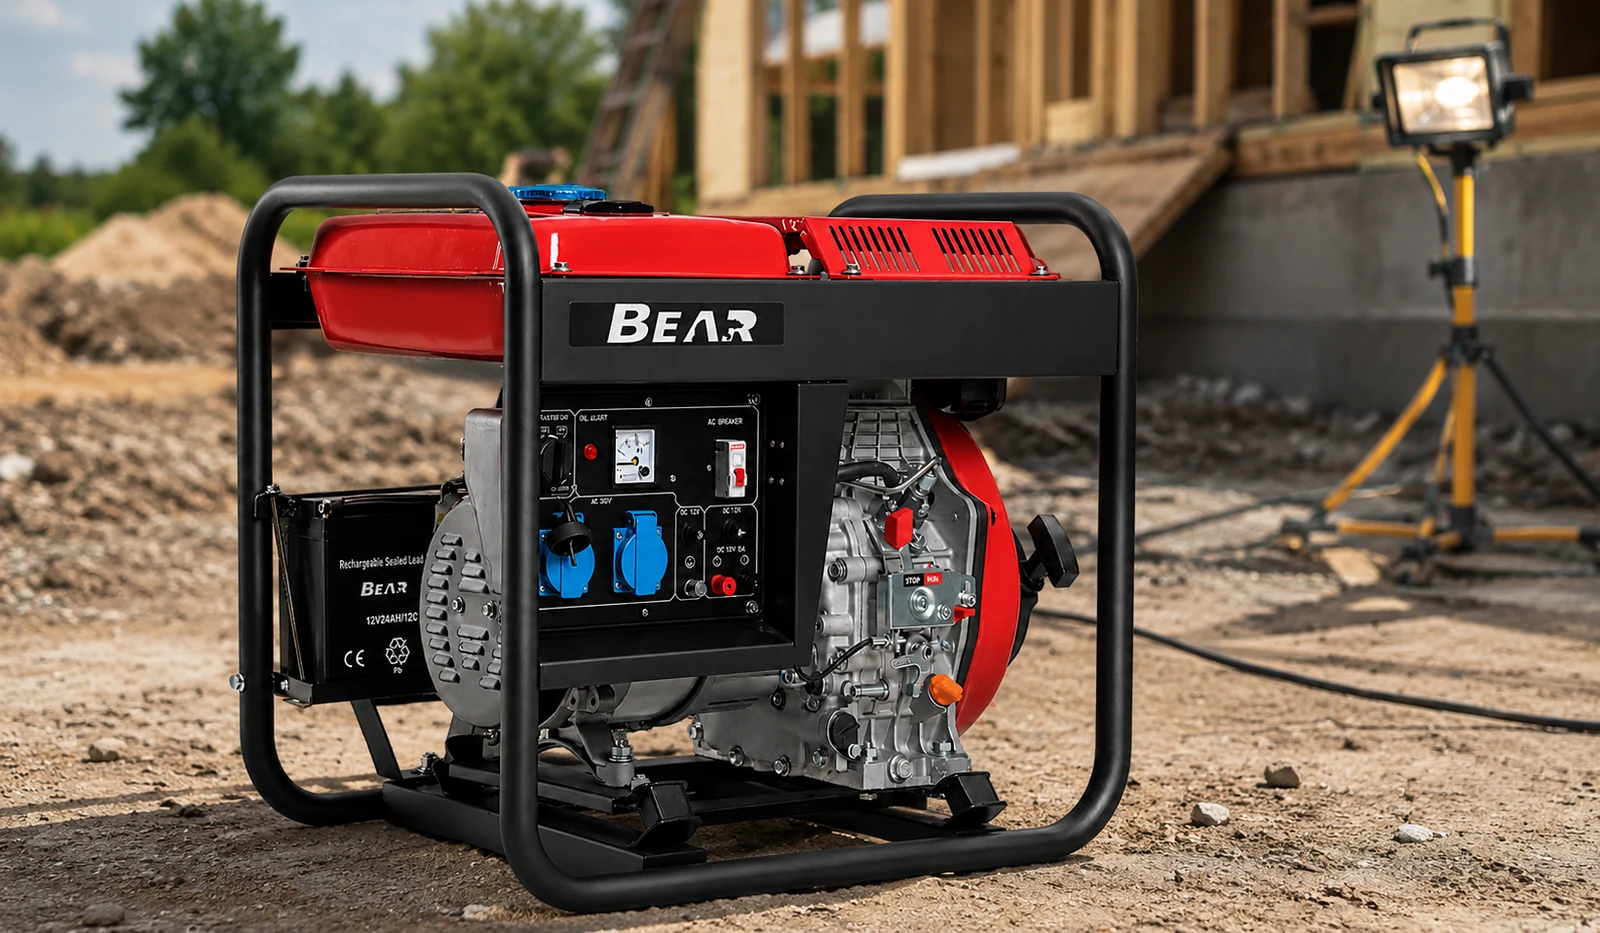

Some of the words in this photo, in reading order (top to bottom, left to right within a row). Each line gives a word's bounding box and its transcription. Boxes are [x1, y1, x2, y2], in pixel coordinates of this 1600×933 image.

[606, 303, 758, 343] BEAR
[340, 558, 384, 570] Rechargeable
[384, 556, 408, 566] Sealed
[408, 554, 424, 565] Lead
[904, 576, 920, 584] STOP
[360, 582, 408, 596] BEAR
